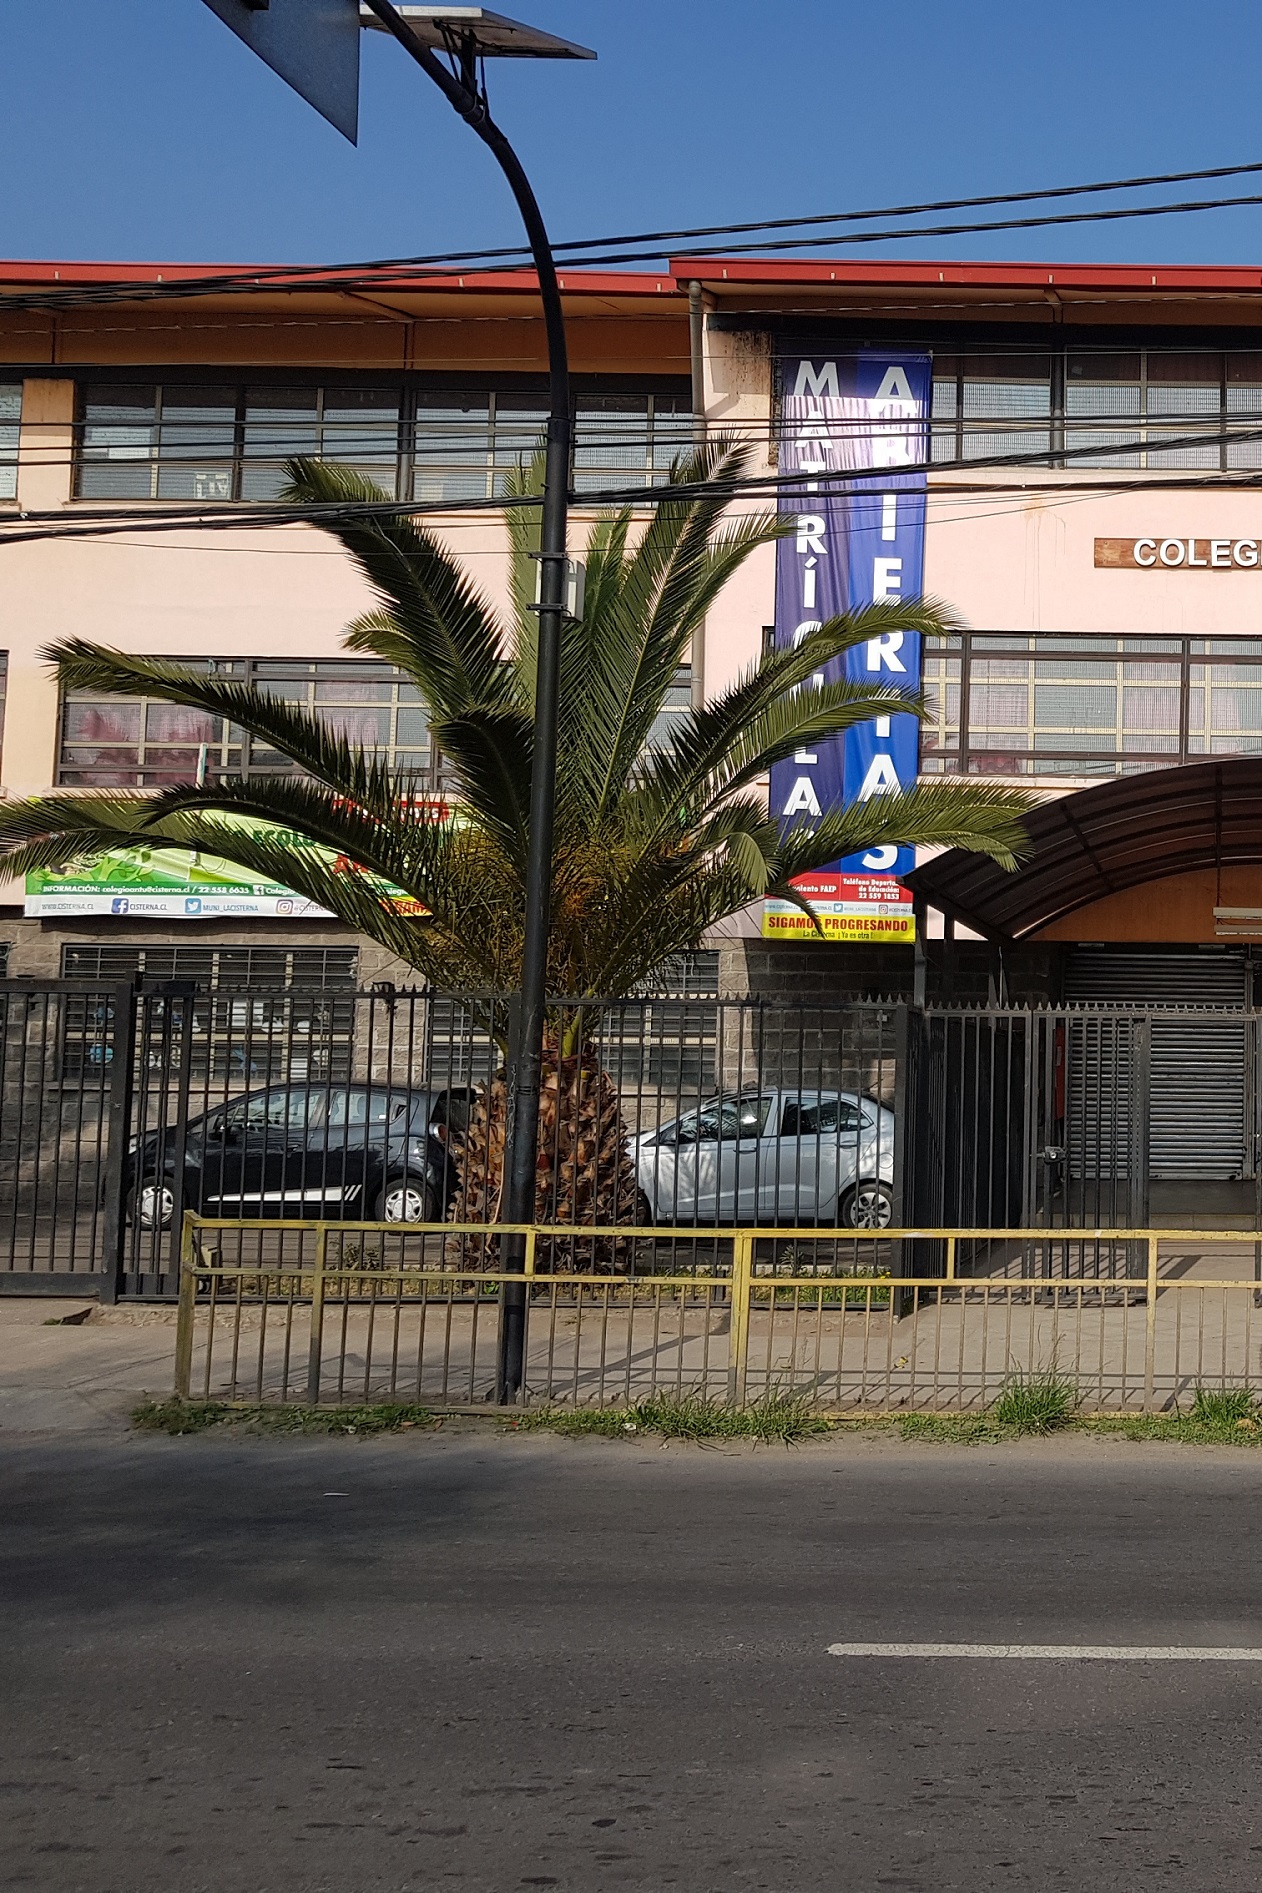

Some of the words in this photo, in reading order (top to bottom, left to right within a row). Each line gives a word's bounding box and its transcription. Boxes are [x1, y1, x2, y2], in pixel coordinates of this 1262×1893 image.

[843, 877, 870, 886] Teléfono
[42, 883, 101, 893] INFORMACIÓN:
[198, 886, 209, 894] 22
[210, 886, 227, 894] 558
[229, 886, 250, 895] 6635
[130, 903, 168, 911] CISTERNA.CL
[203, 904, 259, 912] MUNI_LACISTERNA
[825, 918, 909, 932] PROGRESANDO
